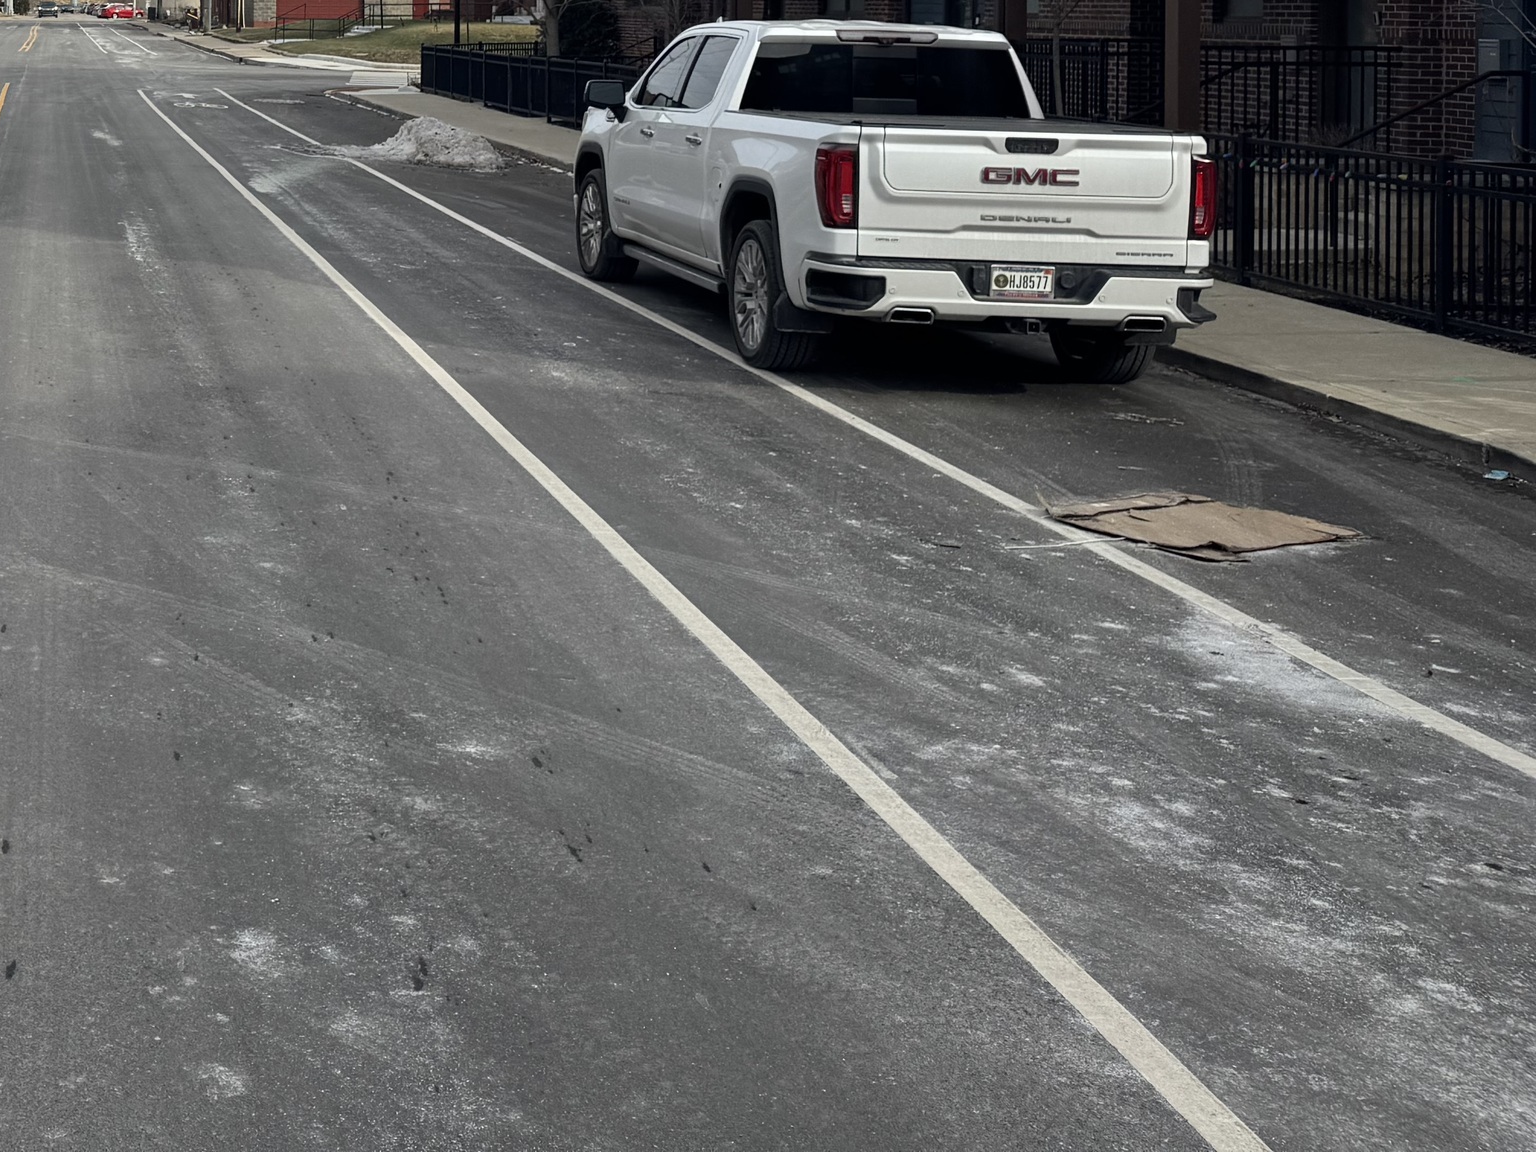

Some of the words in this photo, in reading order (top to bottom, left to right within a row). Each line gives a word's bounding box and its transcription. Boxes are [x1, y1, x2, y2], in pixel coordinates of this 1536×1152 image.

[980, 166, 1080, 187] GMC
[980, 214, 1072, 224] DENALI
[1008, 274, 1049, 290] HJ8577
